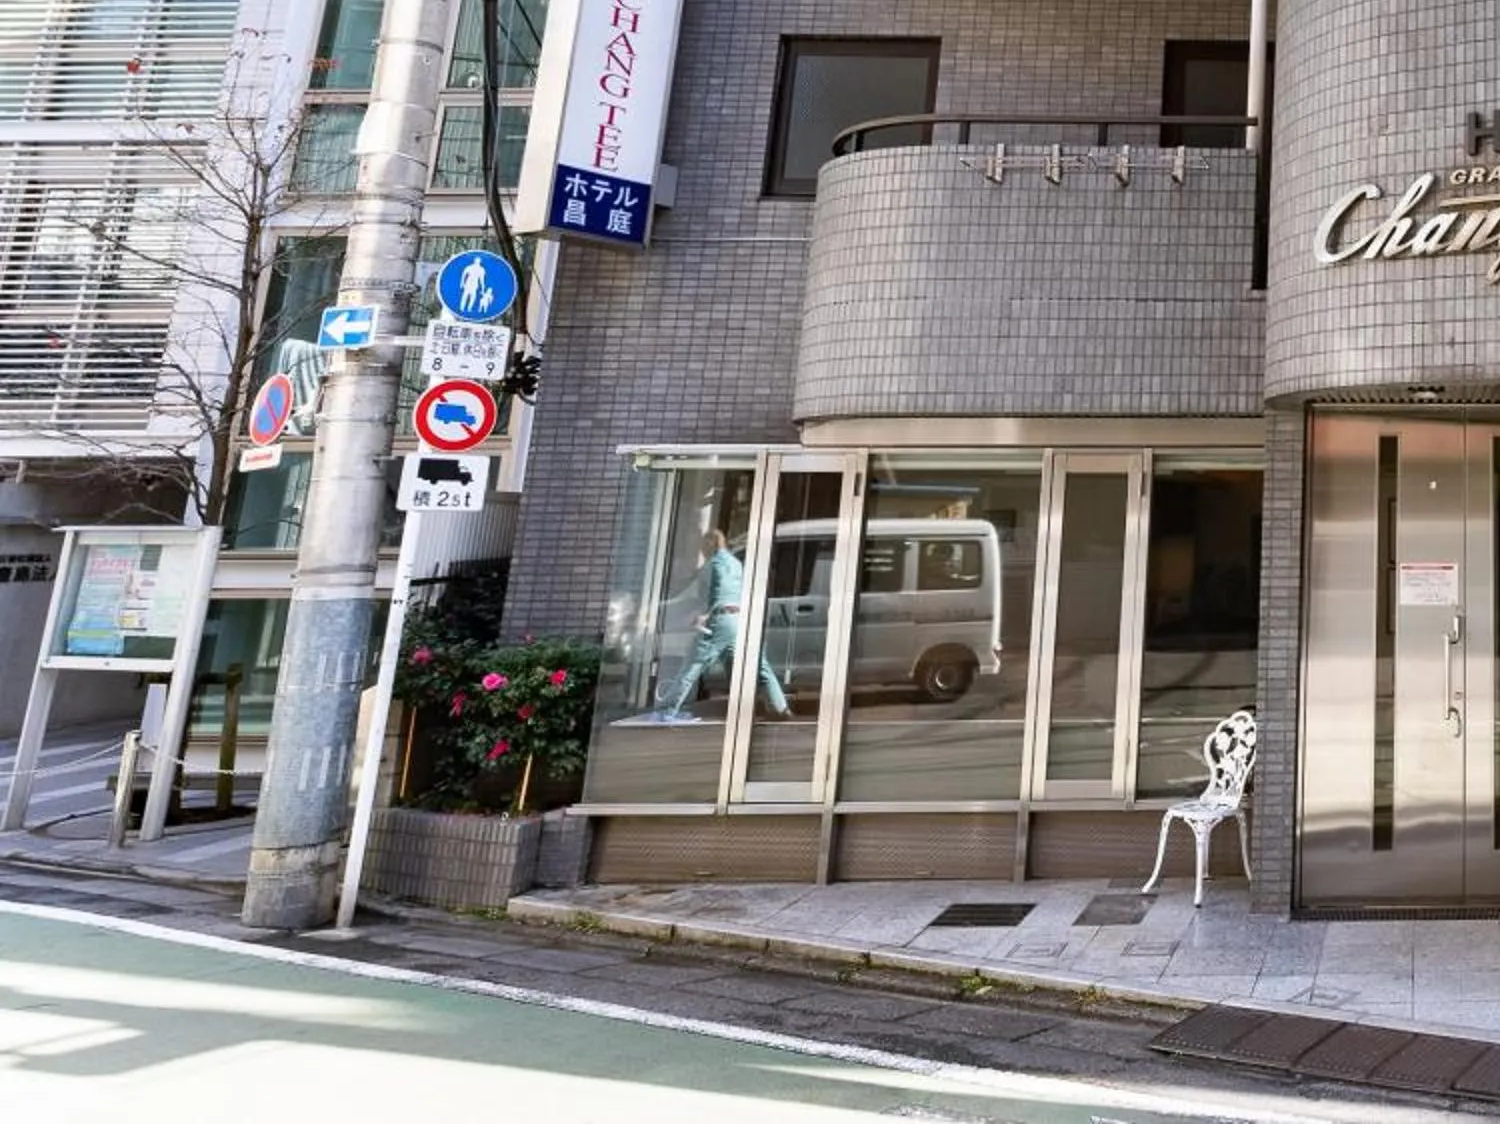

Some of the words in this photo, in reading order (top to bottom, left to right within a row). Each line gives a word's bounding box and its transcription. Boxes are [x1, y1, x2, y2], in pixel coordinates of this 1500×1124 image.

[564, 173, 639, 207] ホテル
[563, 199, 632, 235] 昌庭
[432, 357, 443, 371] 8
[486, 362, 495, 375] 9
